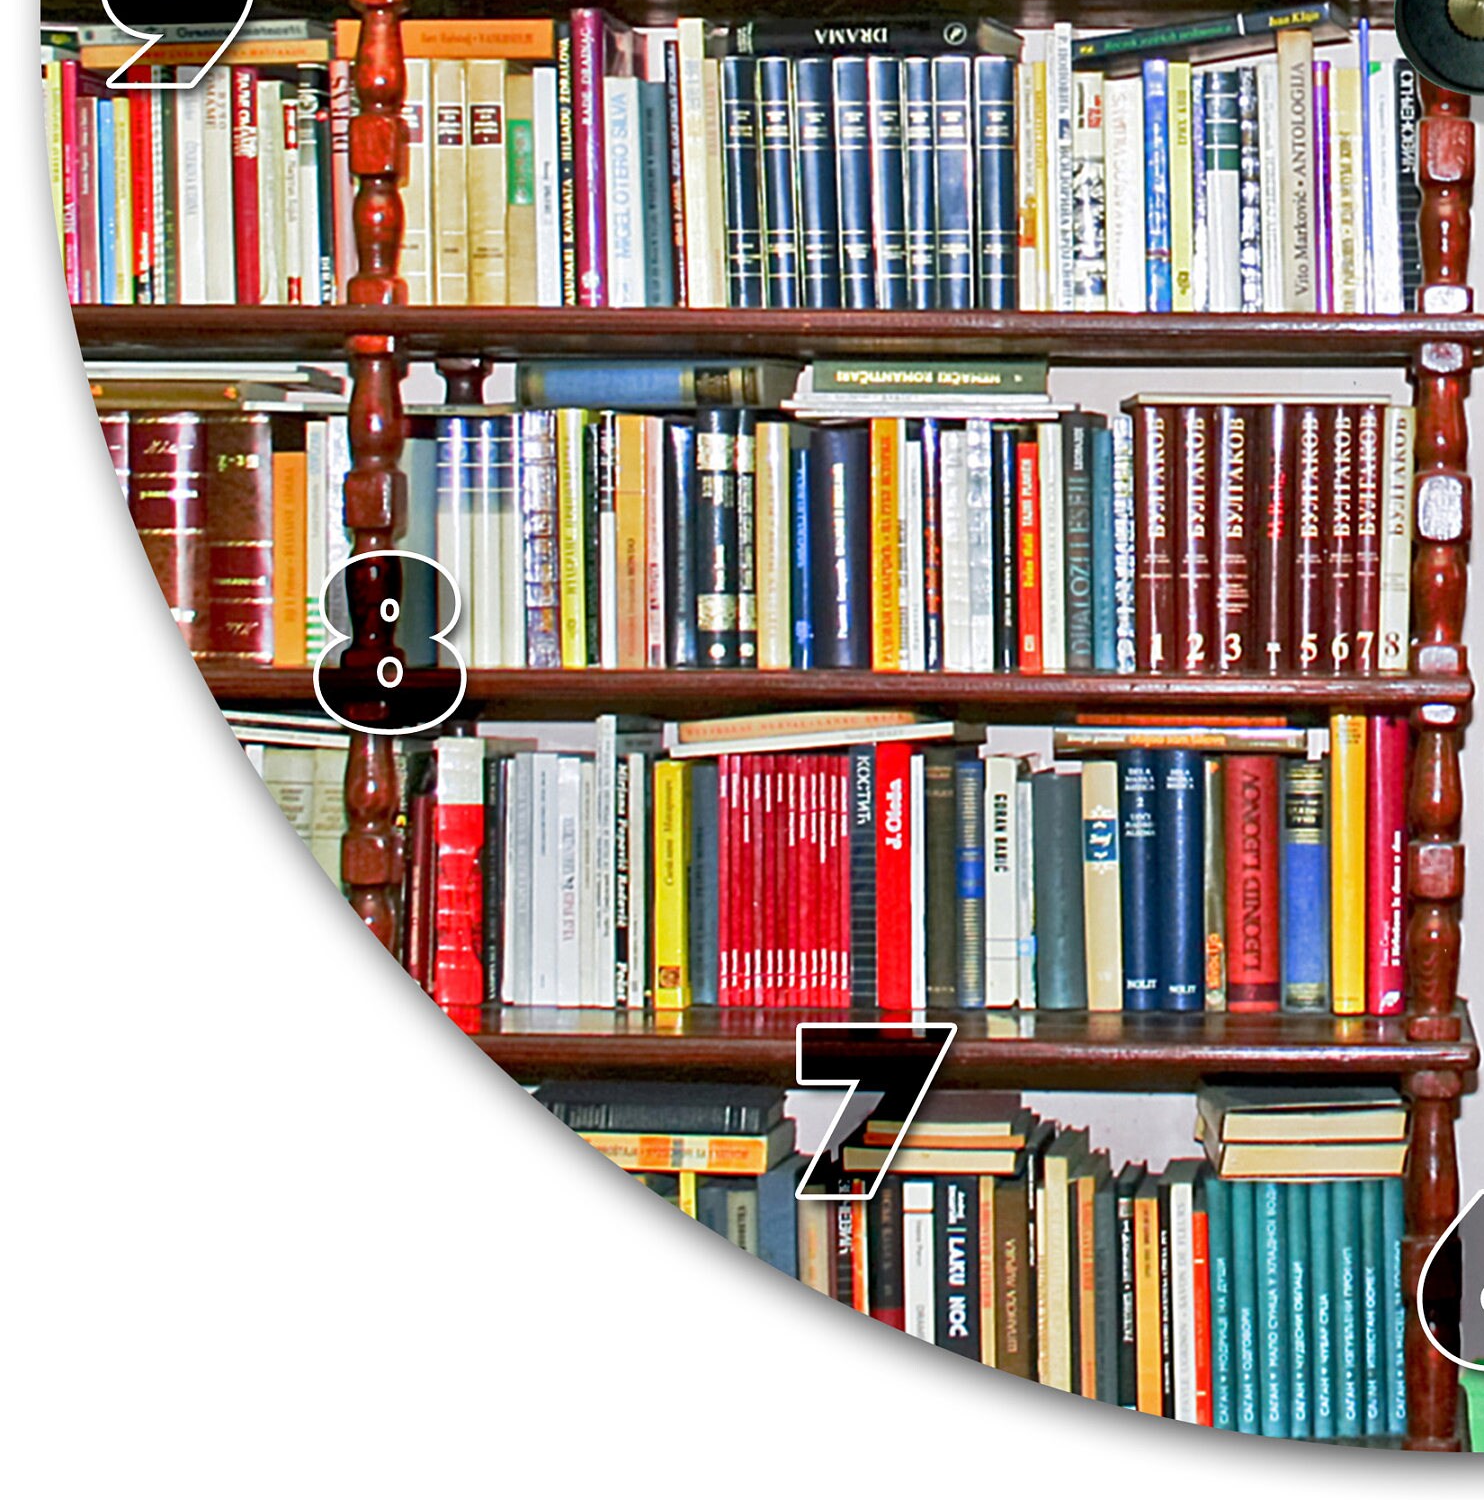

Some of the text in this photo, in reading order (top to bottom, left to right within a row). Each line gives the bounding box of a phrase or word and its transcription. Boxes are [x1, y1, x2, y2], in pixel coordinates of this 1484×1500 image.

[814, 28, 888, 43] DRAMA
[560, 107, 573, 243] KAVABATA HILJADU
[611, 93, 631, 260] MIGEL OTERO SILVA
[1291, 62, 1309, 296] Vito Marković ANTOLOGIJA
[1149, 417, 1165, 538] БУЛГАКОВ
[1189, 417, 1205, 538] БУЛГАКОВ
[1227, 417, 1244, 538] БУЛГАКОВ
[1302, 417, 1319, 538] БУЛГАКОВ
[1333, 415, 1350, 537] БУЛГАКОВ
[1358, 414, 1376, 536] БУЛГАКОВ
[1389, 417, 1408, 537] БУЛГАКОВ
[313, 550, 467, 734] 8
[1152, 633, 1164, 660] 1
[1187, 632, 1205, 661] 2
[1225, 632, 1242, 661] 3
[1300, 632, 1318, 662] 5
[1332, 632, 1349, 661] 6
[1357, 630, 1374, 659] 7
[1384, 631, 1400, 657] 8
[857, 755, 872, 825] КОСТИЋ
[1241, 770, 1262, 973] LEONID LEONOV
[795, 1023, 957, 1199] 7
[949, 1235, 969, 1338] LAKU NOĆ
[1218, 1385, 1229, 1425] САГАН
[1243, 1384, 1254, 1423] САГАН
[1268, 1382, 1279, 1422] САГАН
[1295, 1381, 1306, 1421] САГАН
[1319, 1377, 1330, 1417] САГАН
[1345, 1381, 1356, 1420] САГАН
[1367, 1379, 1378, 1419] САГАН
[1395, 1380, 1406, 1419] САГАН
